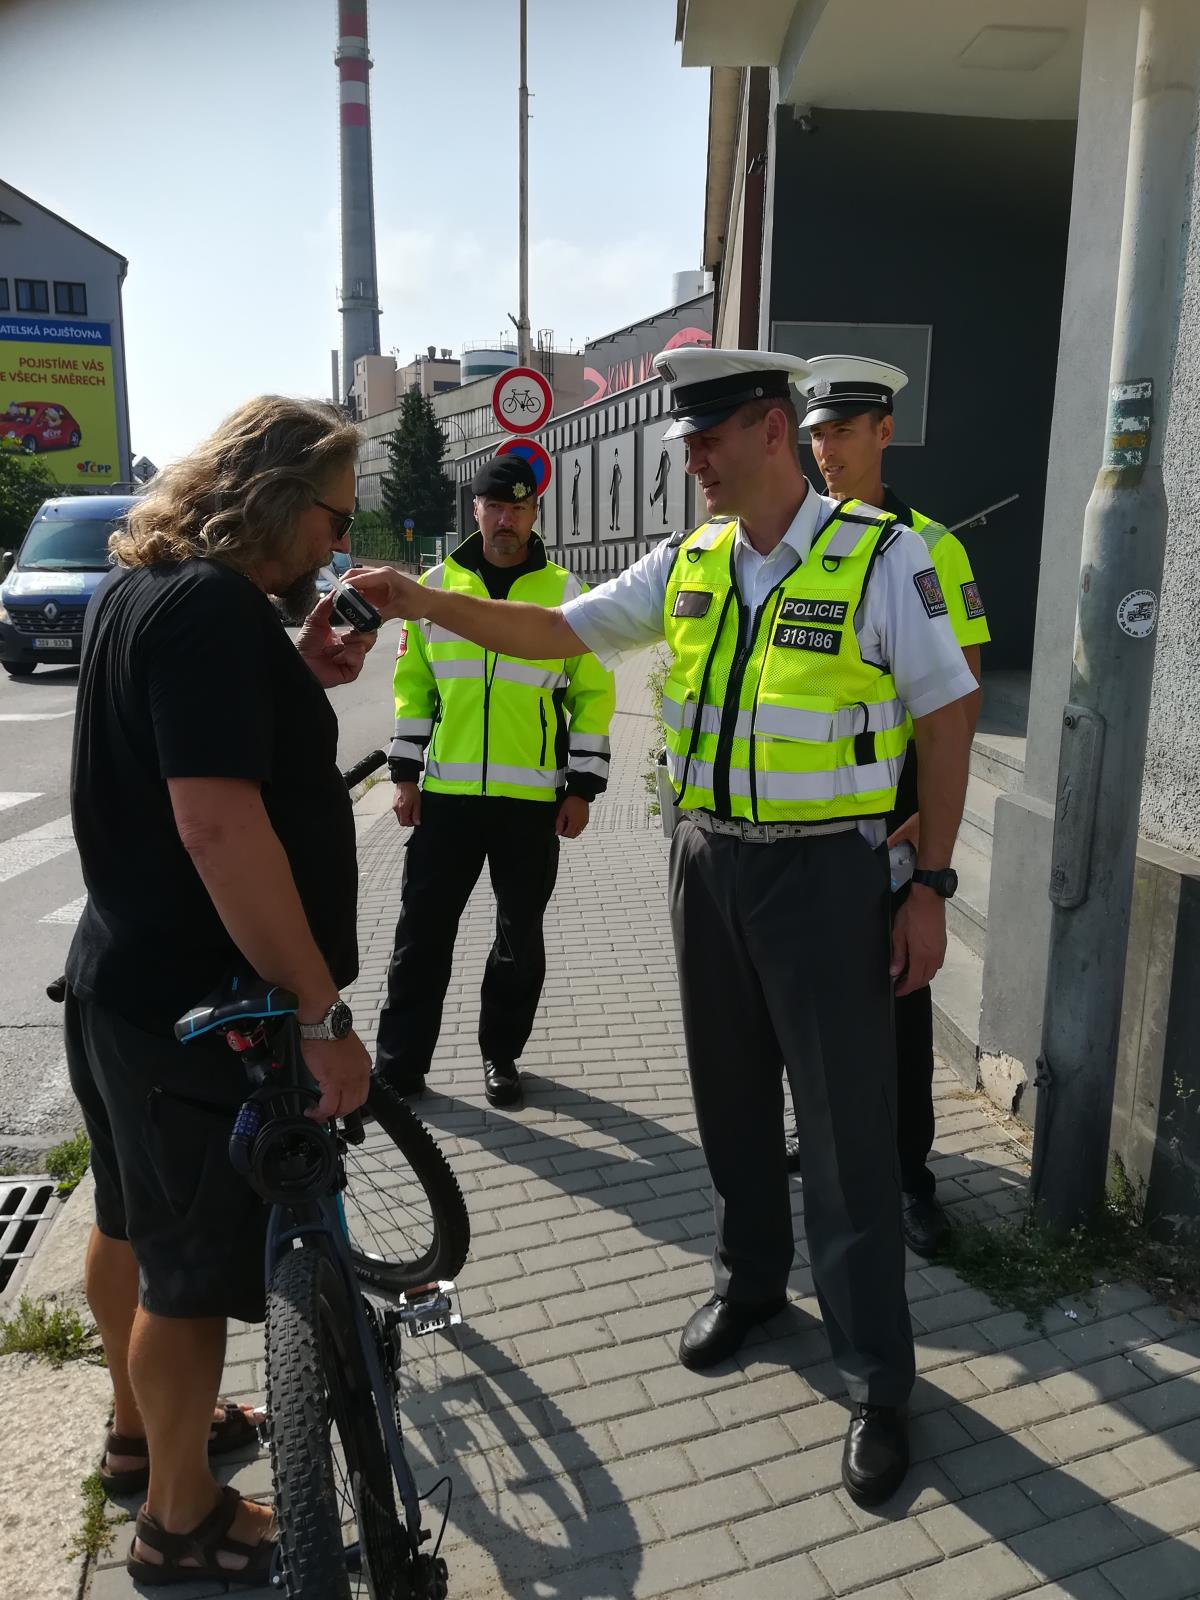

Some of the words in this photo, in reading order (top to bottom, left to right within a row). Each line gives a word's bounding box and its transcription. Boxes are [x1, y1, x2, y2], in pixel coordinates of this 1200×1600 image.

[43, 326, 102, 339] POJIŠŤOVNA
[19, 356, 78, 370] POJISTÍME
[82, 358, 105, 372] VÁS
[8, 370, 48, 384] VŠECH
[51, 372, 106, 386] SMĚRECH
[783, 602, 845, 618] POLICIE
[780, 628, 834, 649] 318186
